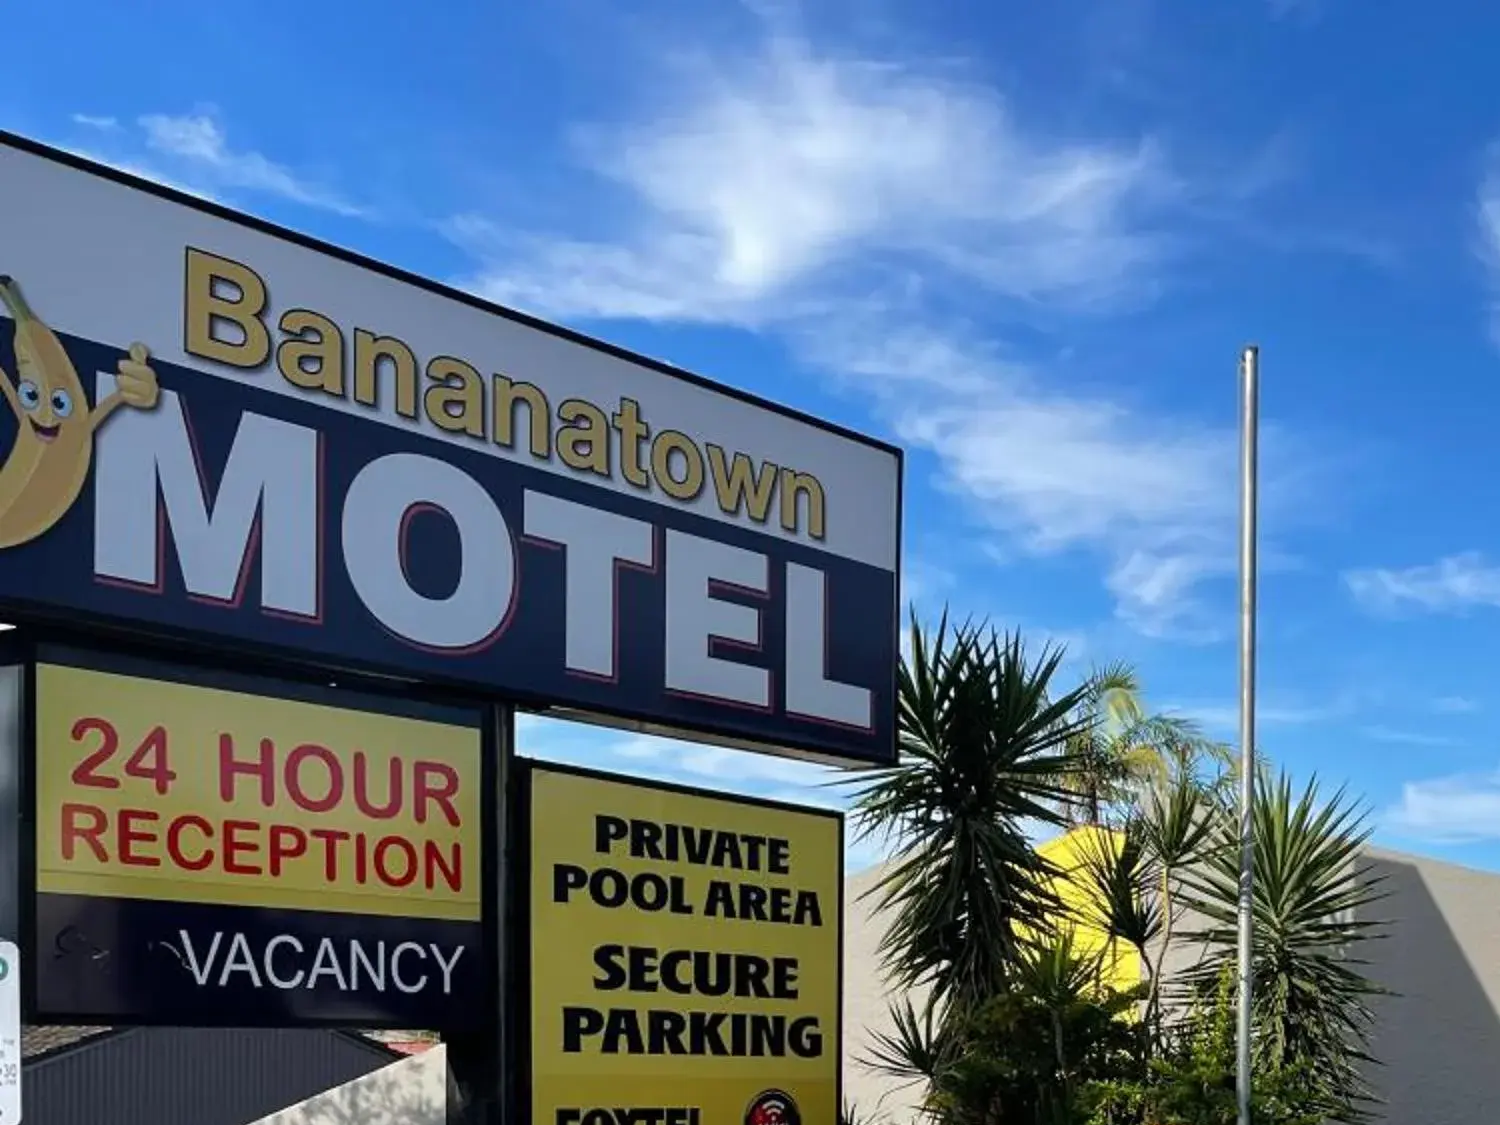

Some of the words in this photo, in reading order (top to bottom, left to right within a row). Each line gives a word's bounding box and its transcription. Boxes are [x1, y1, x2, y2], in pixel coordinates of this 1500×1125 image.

[183, 245, 828, 541] Bananatown
[93, 369, 877, 735] MOTEL
[70, 717, 177, 796] 24
[219, 733, 462, 828] HOUR
[60, 802, 464, 893] RECEPTION
[594, 813, 790, 875] PRIVATE
[553, 863, 694, 915] POOL
[703, 879, 823, 927] AREA
[178, 929, 466, 995] VACANCY
[592, 943, 799, 1000] SECURE
[562, 1006, 823, 1058] PARKING
